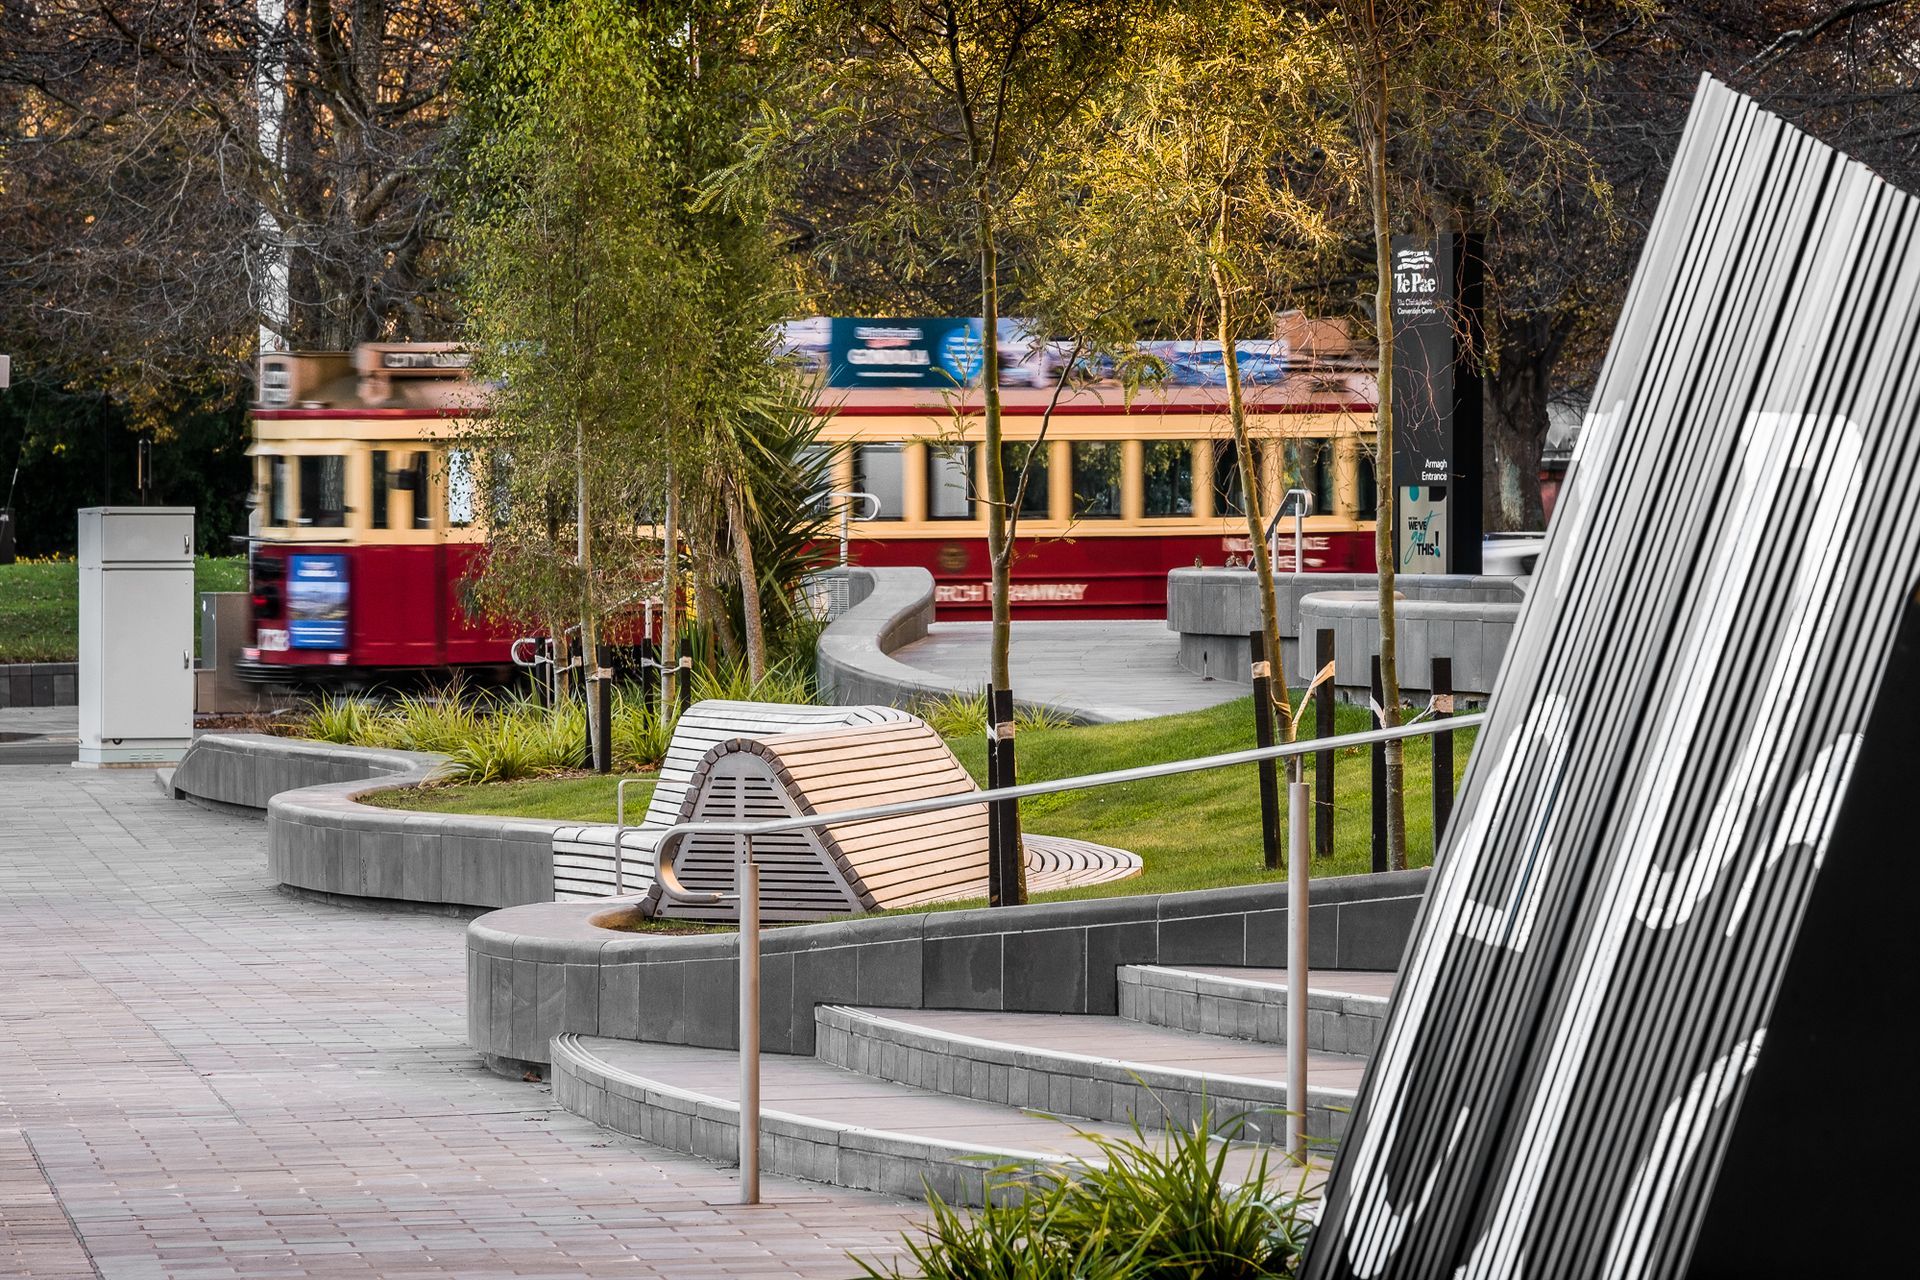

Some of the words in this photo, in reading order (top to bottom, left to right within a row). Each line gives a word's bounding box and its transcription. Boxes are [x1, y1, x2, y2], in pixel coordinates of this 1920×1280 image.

[1394, 273, 1410, 293] Te
[1411, 272, 1435, 293] Pae
[1425, 459, 1447, 471] Armagh
[1422, 471, 1447, 481] Entrance
[1408, 520, 1427, 531] WE'VE
[935, 585, 984, 602] RCH
